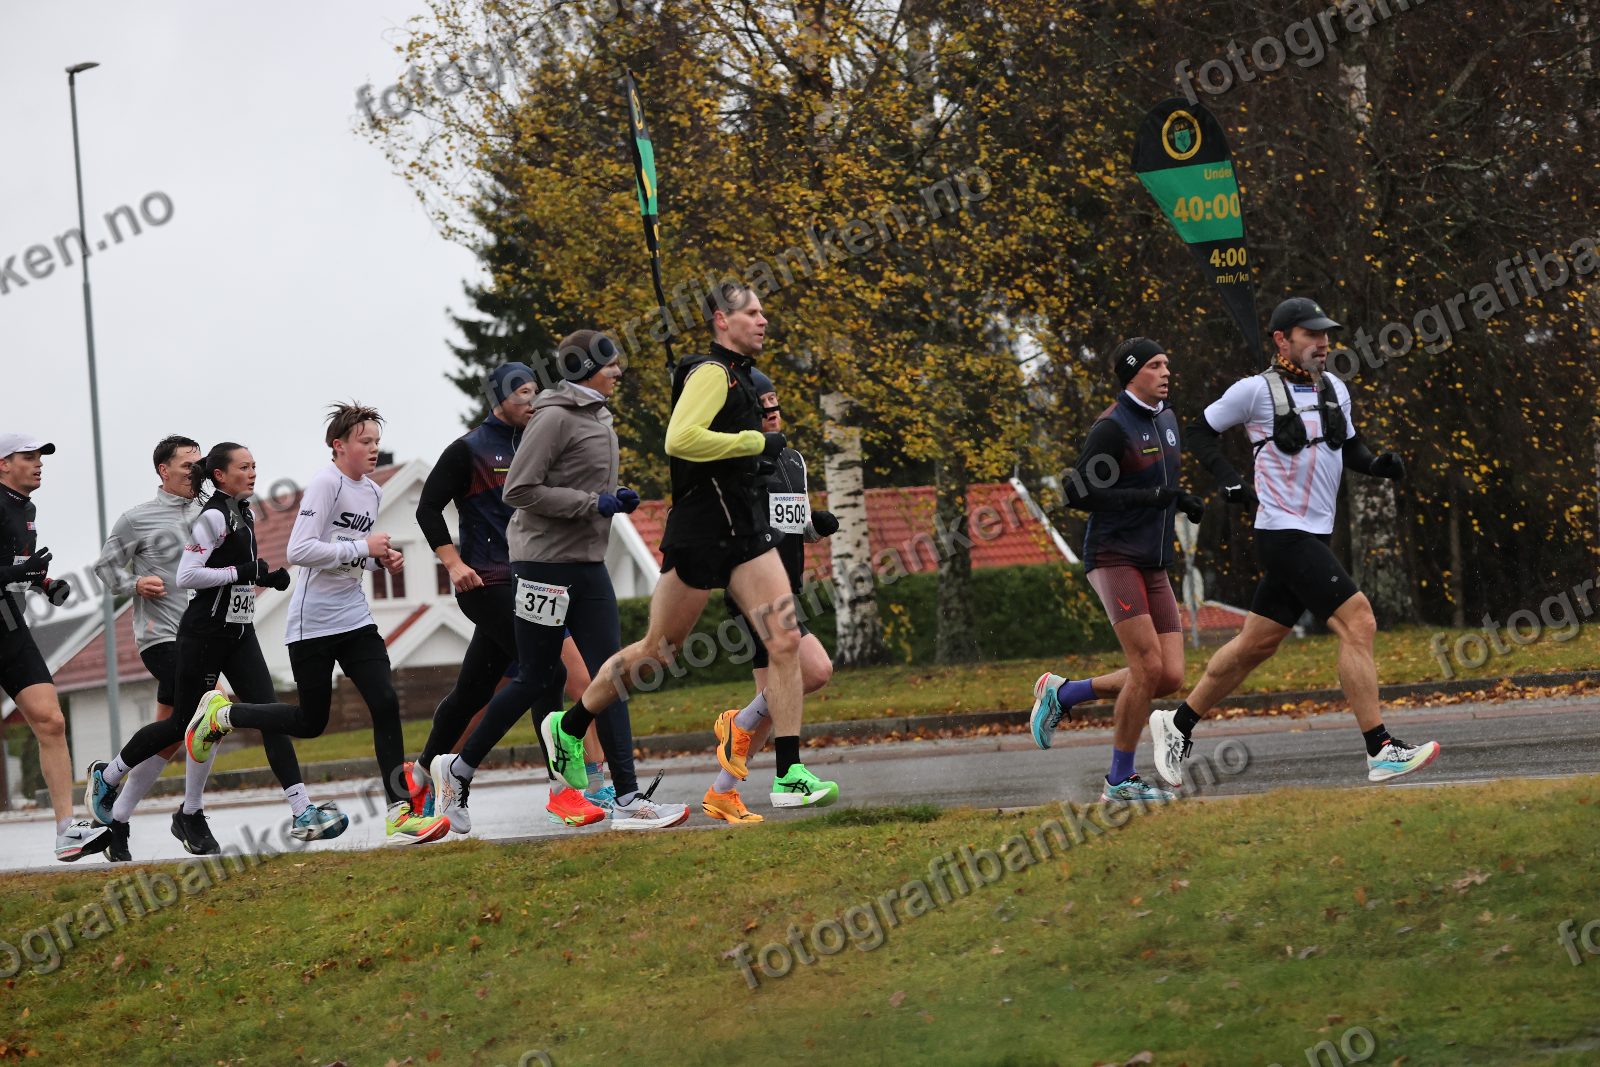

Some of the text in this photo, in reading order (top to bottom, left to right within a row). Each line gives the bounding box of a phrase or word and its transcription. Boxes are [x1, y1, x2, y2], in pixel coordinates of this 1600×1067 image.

[1203, 167, 1232, 180] Under
[1174, 192, 1240, 222] 40:00
[1210, 247, 1247, 267] 4:00
[775, 503, 806, 524] 9509
[524, 592, 557, 616] 371
